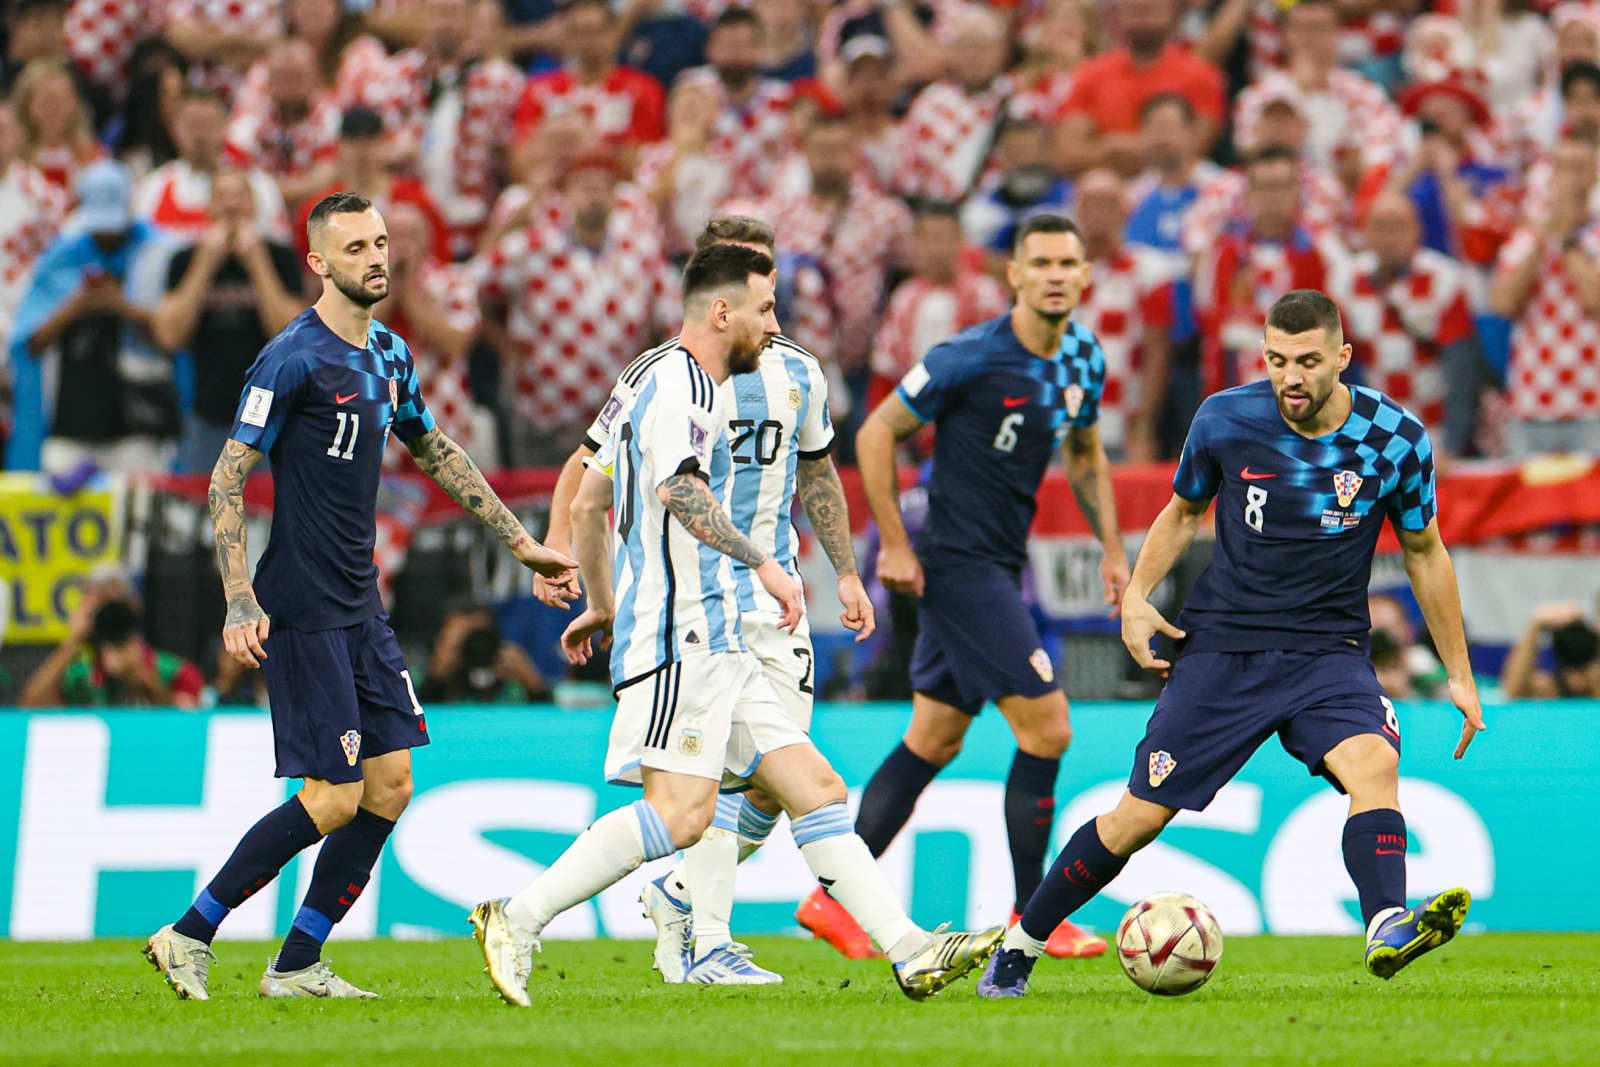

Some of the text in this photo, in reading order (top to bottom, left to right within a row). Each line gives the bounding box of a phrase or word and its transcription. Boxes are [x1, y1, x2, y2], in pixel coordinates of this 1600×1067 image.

[326, 411, 360, 461] 11
[728, 418, 784, 466] 20
[992, 413, 1025, 453] 6
[1244, 484, 1268, 534] 8
